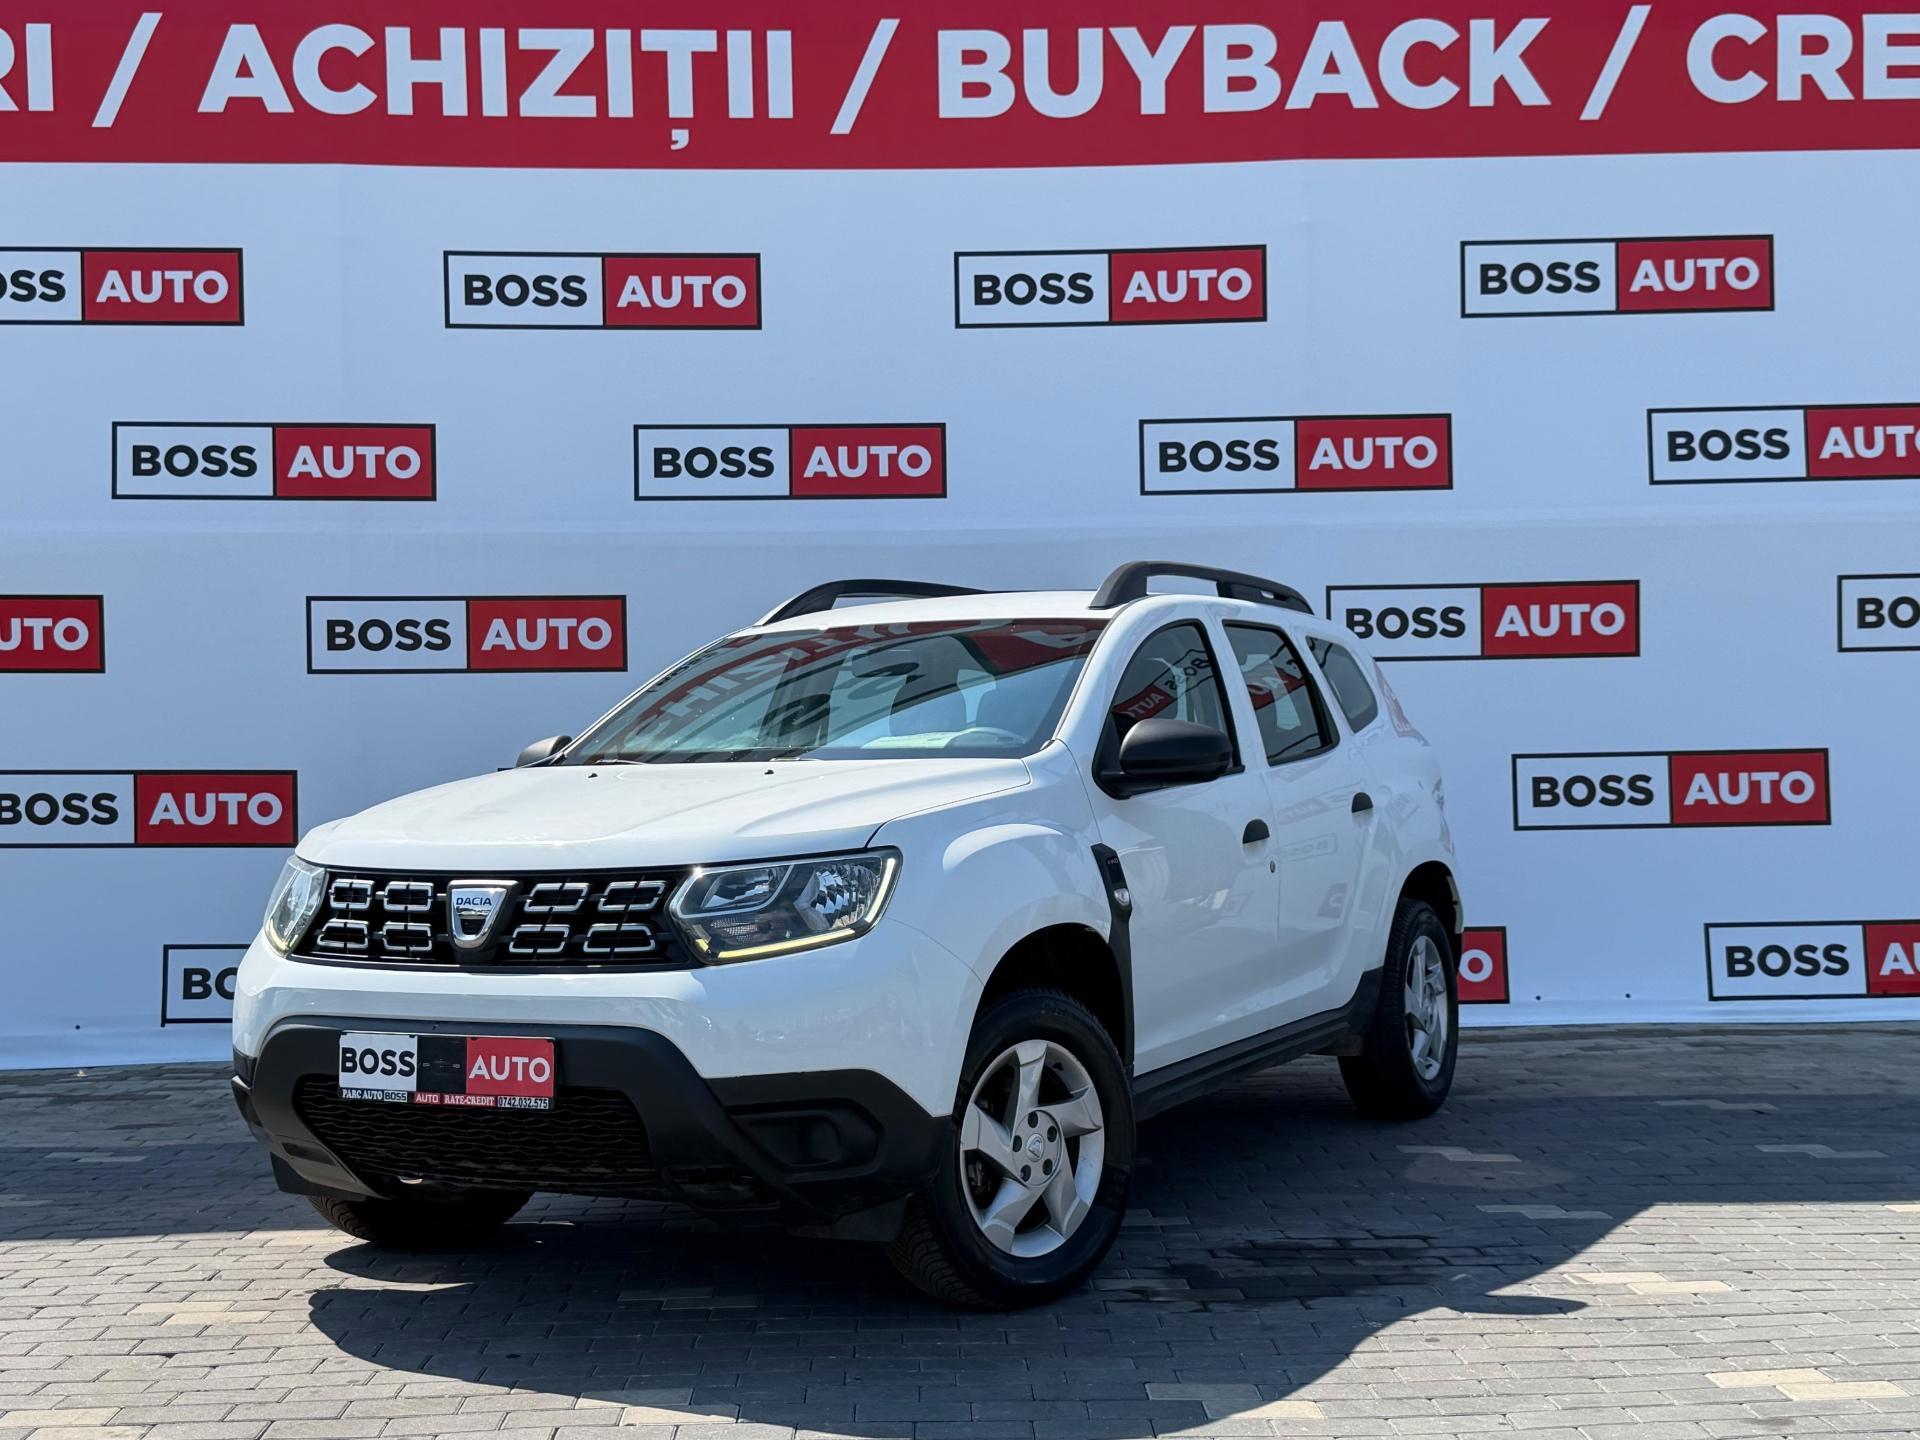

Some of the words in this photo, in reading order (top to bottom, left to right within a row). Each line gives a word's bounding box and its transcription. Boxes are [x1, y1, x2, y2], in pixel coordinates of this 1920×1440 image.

[198, 24, 793, 149] ACHIZIȚII
[938, 18, 1551, 118] BUYBACK
[96, 270, 228, 303] AUTO
[464, 275, 587, 307] BOSS
[618, 276, 746, 308] AUTO
[974, 273, 1093, 305] BOSS
[1123, 268, 1251, 303] AUTO
[1480, 261, 1600, 294] BOSS
[1630, 257, 1759, 291] AUTO
[1159, 439, 1279, 472] BOSS
[1309, 436, 1437, 469] AUTO
[1668, 428, 1789, 461] BOSS
[1820, 426, 1920, 458] AUT
[133, 445, 257, 477] BOSS
[288, 446, 420, 478] AUTO
[654, 447, 774, 478] BOSS
[804, 445, 931, 477] AUTO
[327, 619, 451, 651] BOSS
[482, 618, 611, 650] AUTO
[1346, 607, 1465, 639] BOSS
[1495, 603, 1625, 637] AUTO
[1532, 774, 1653, 807] BOSS
[1684, 771, 1814, 805] AUTO
[149, 793, 282, 825] AUTO
[456, 897, 492, 906] DACIA
[1726, 944, 1849, 977] BOSS
[341, 1047, 415, 1077] BOSS
[469, 1055, 550, 1083] AUTO
[342, 1089, 361, 1099] PARC
[362, 1090, 383, 1100] AUTO
[385, 1092, 406, 1101] BOSS
[416, 1094, 439, 1103] AUTO
